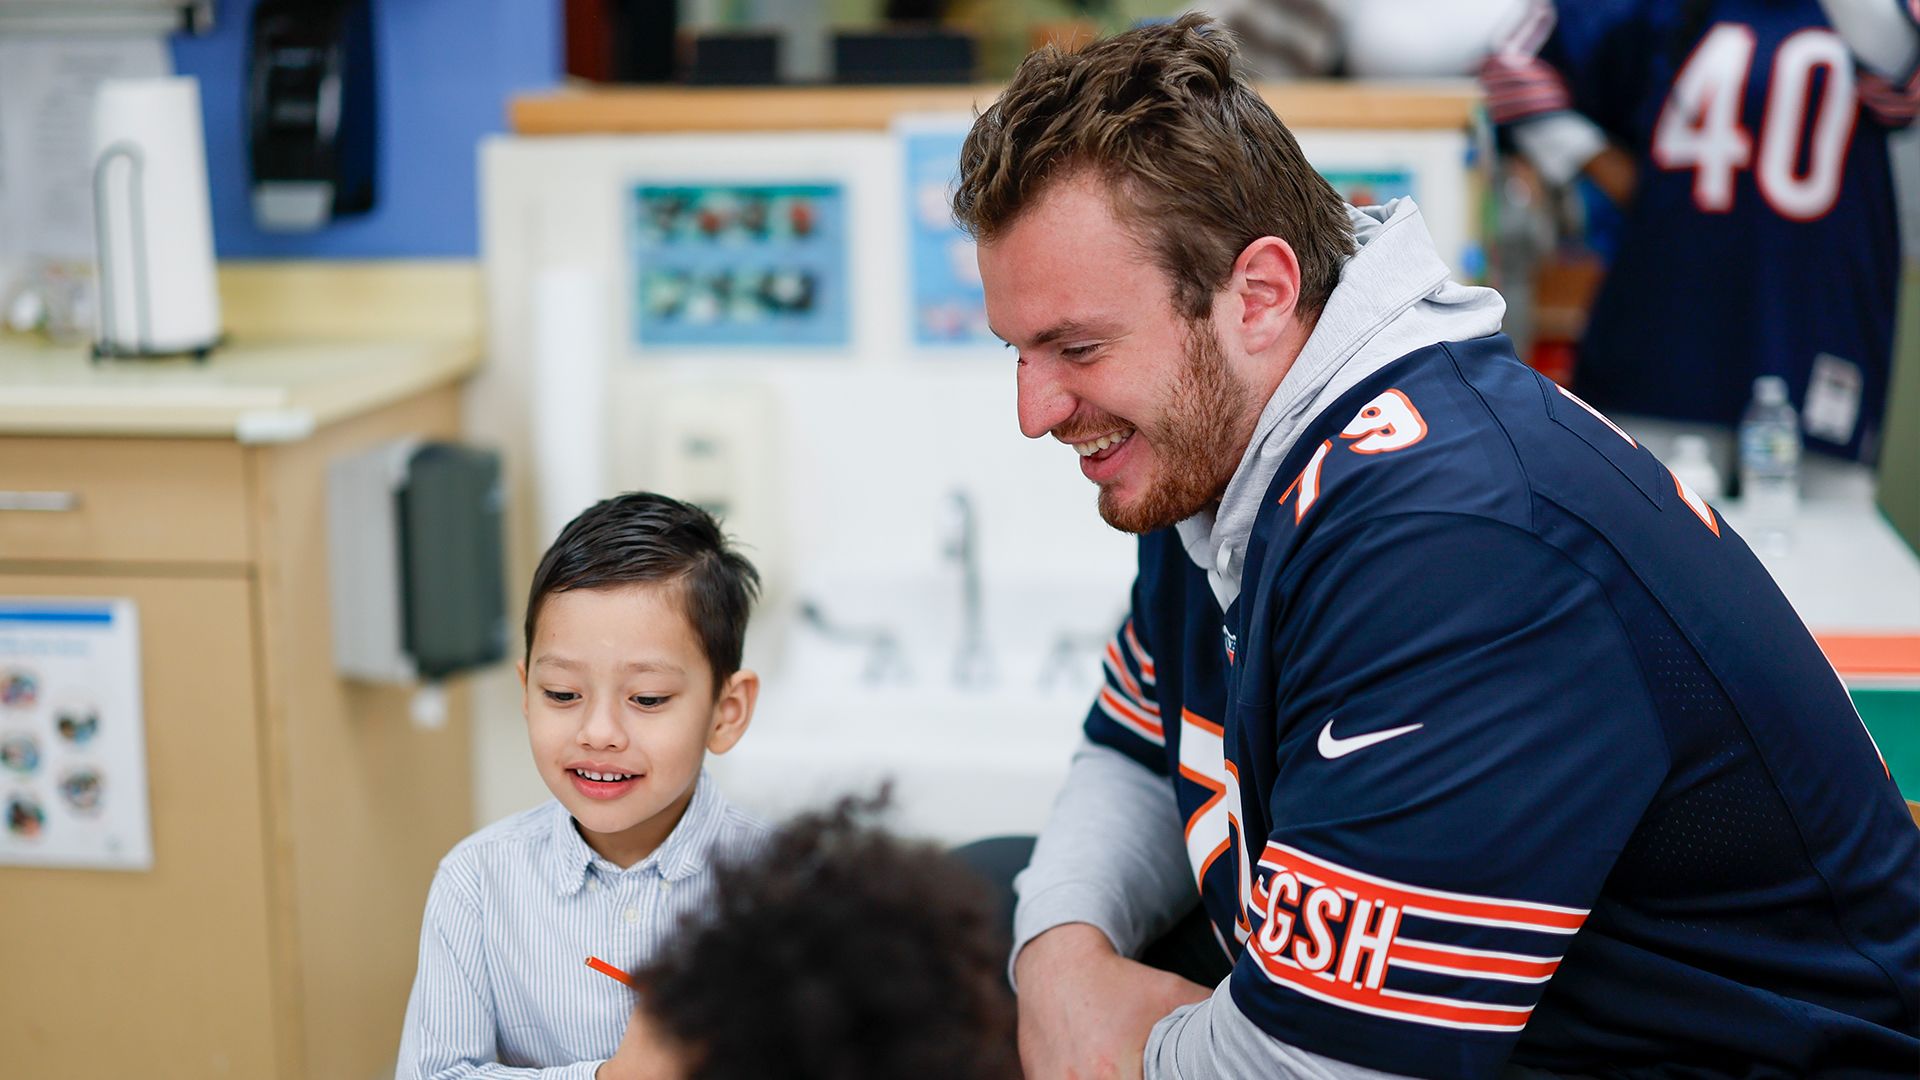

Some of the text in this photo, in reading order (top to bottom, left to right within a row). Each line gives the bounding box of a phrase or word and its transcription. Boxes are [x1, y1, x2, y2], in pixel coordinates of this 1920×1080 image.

[1652, 22, 1860, 223] 40
[1278, 388, 1428, 526] 79
[1258, 869, 1403, 991] GSH
